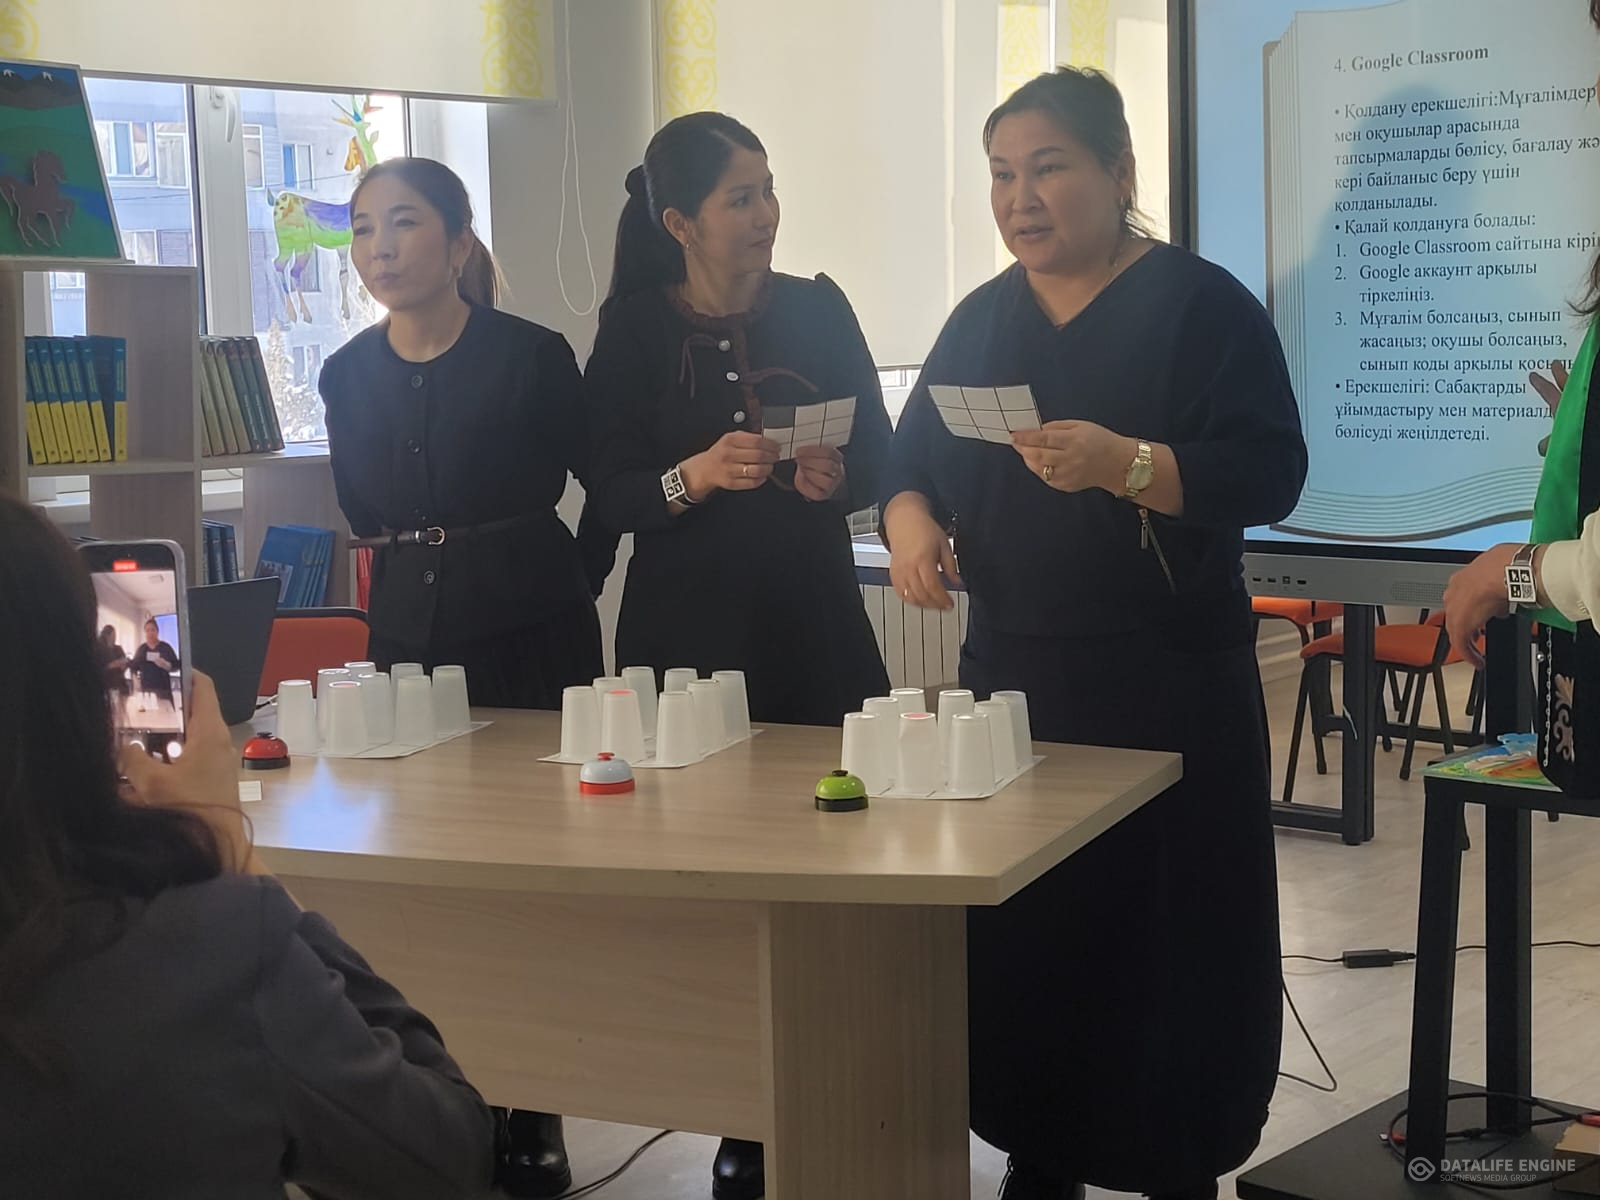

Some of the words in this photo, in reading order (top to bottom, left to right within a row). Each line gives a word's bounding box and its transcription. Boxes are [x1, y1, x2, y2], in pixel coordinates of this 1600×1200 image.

[1334, 57, 1347, 72] 4.
[1351, 53, 1403, 72] Google
[1408, 47, 1489, 66] Classroom
[1345, 103, 1407, 120] Қолдану
[1335, 130, 1361, 143] мен
[1447, 118, 1520, 137] арасында
[1335, 147, 1450, 167] тапсырмаларды
[1335, 172, 1362, 192] кері
[1367, 171, 1438, 187] байланыс
[1443, 167, 1477, 186] беру
[1483, 163, 1520, 184] үшін
[1345, 218, 1388, 236] Қалай
[1474, 213, 1536, 228] болады:
[1336, 244, 1347, 257] 1.
[1360, 240, 1410, 259] Google
[1414, 238, 1491, 255] Classroom
[1496, 235, 1561, 251] сайтына
[1335, 266, 1347, 280] 2.
[1360, 264, 1410, 282] Google
[1414, 265, 1473, 280] аккаунт
[1477, 263, 1537, 279] арқылы
[1360, 286, 1434, 306] тіркеліңіз.
[1335, 312, 1347, 326] 3.
[1508, 311, 1561, 322] сынып
[1360, 336, 1427, 349] жасаңыз;
[1431, 335, 1483, 351] оқушы
[1360, 360, 1408, 371] сынып
[1413, 360, 1449, 372] коды
[1454, 359, 1513, 374] арқылы
[1345, 378, 1430, 397] Ерекшелігі:
[1434, 378, 1526, 397] Сабақтарды
[1439, 406, 1467, 417] мен
[1397, 425, 1490, 441] жеңілдетеді.
